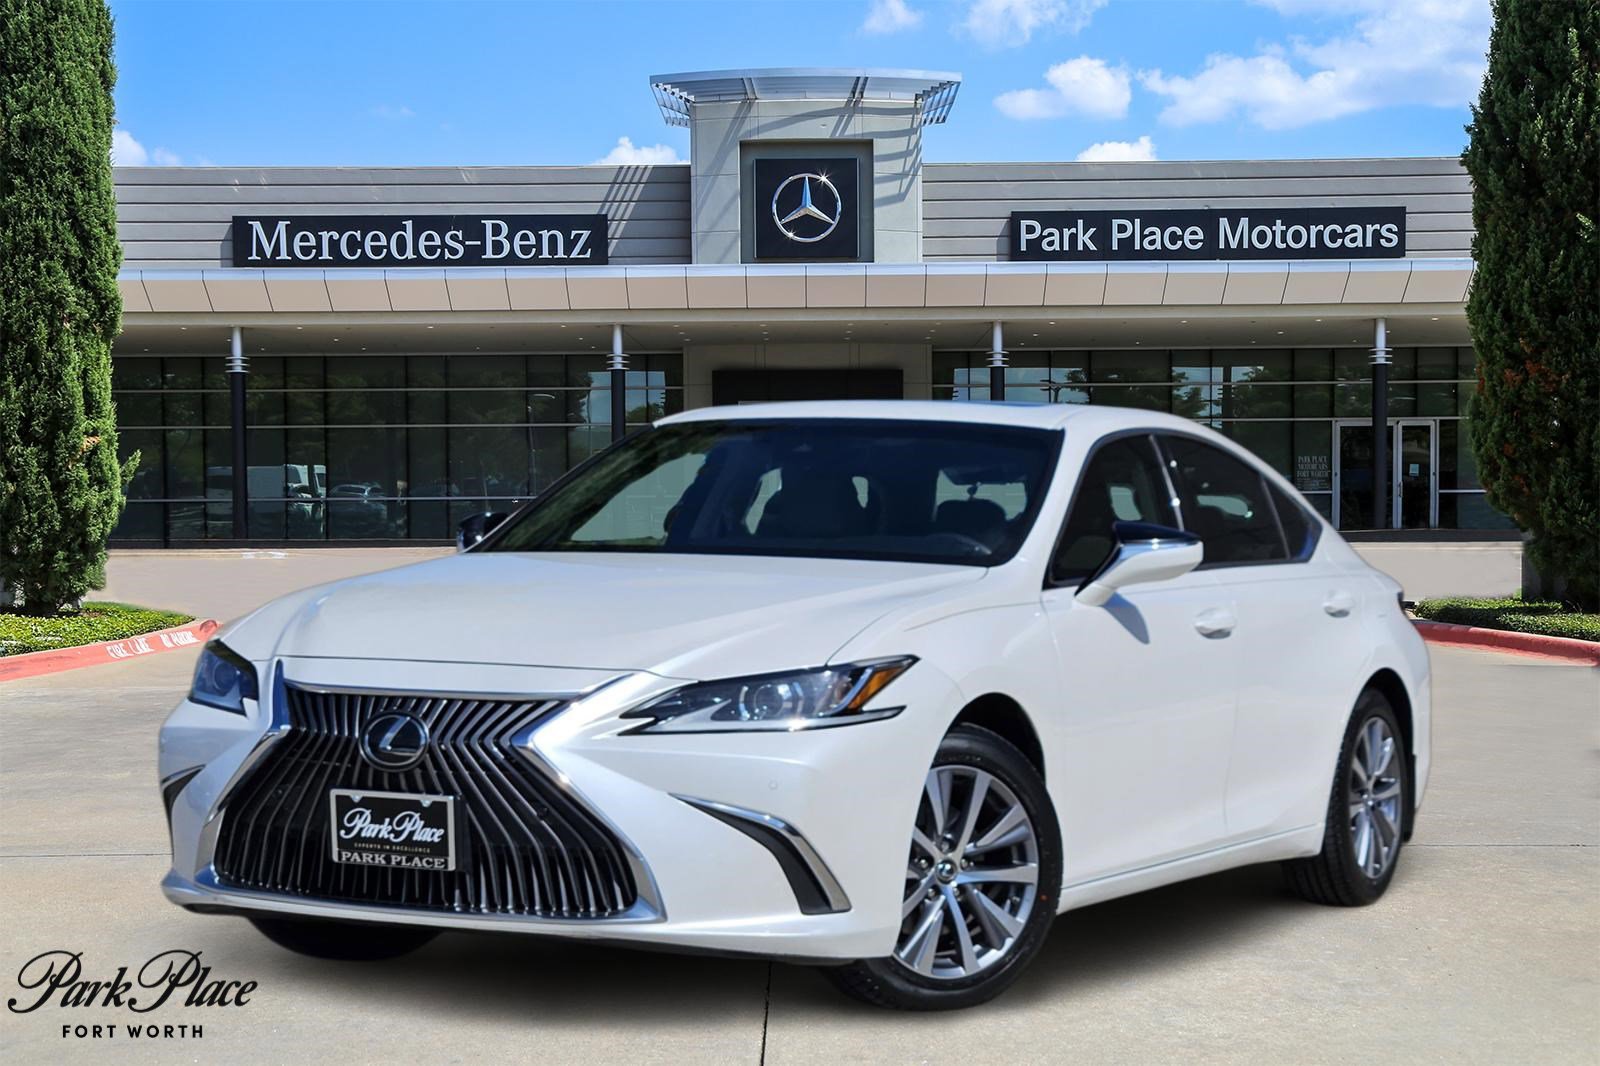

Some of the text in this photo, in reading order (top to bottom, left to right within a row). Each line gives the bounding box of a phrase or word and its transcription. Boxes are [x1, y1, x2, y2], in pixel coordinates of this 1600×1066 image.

[247, 219, 593, 261] Mercedes-Benz
[1019, 216, 1399, 252] Park Place Motorcars
[339, 807, 445, 843] Park Place
[341, 850, 445, 870] PARK PLACE
